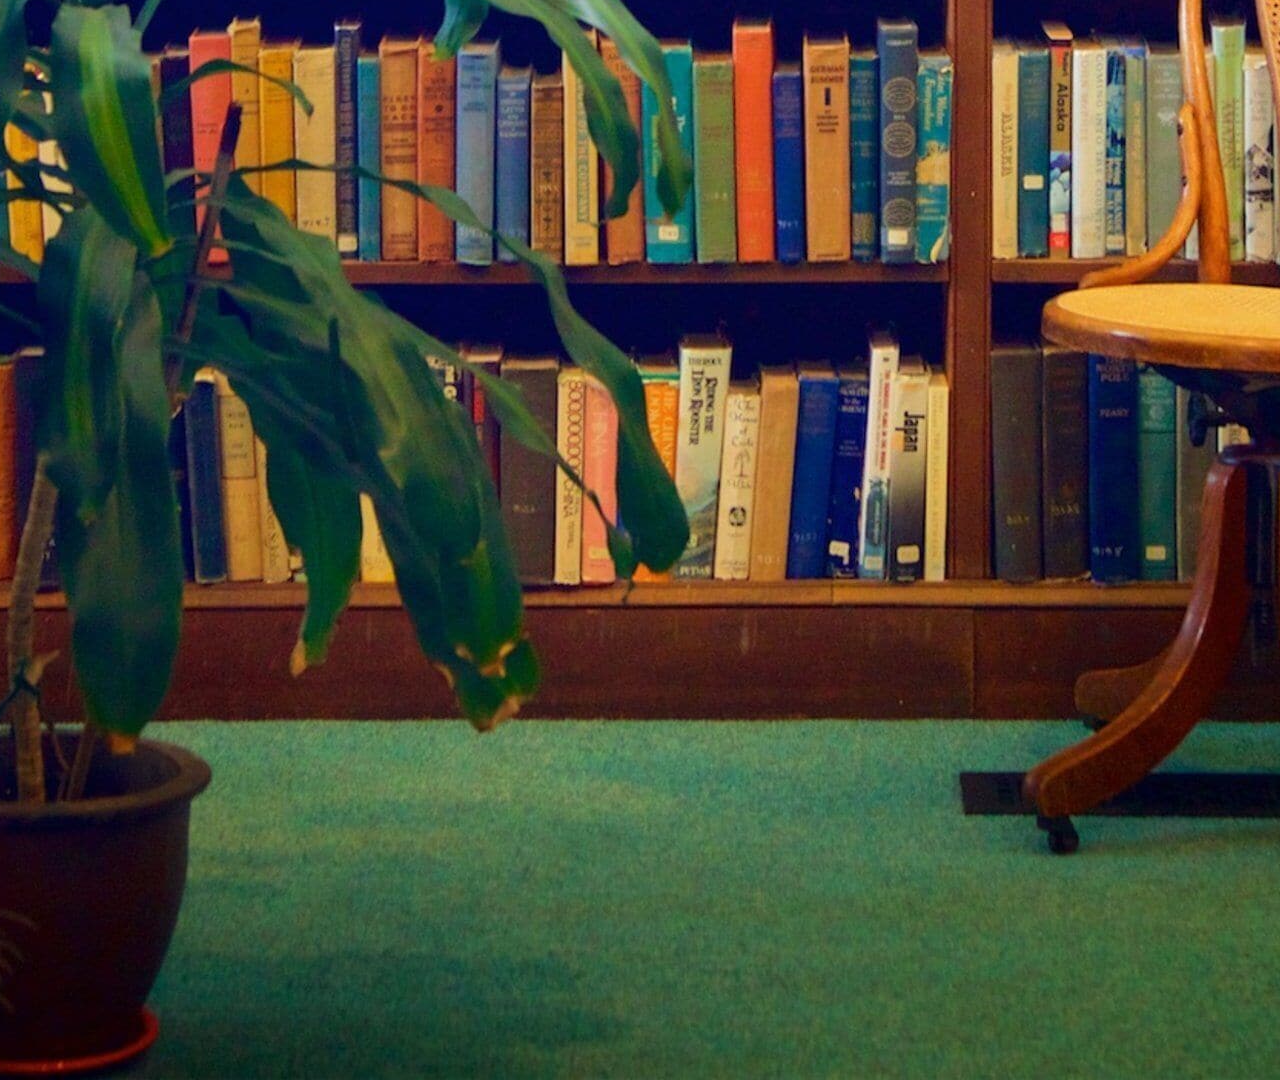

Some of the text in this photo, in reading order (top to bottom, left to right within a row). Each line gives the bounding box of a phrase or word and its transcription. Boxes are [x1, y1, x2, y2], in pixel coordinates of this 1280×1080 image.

[1055, 82, 1068, 133] Alaska
[1001, 111, 1014, 178] ALASKA
[1094, 54, 1105, 242] COMING INTO THE COUNTRY
[577, 164, 589, 223] COMPANY
[688, 369, 705, 446] IRON ROOSTER
[703, 376, 717, 434] RIDING THE
[895, 410, 925, 453] Japan
[562, 479, 575, 519] CHINA
